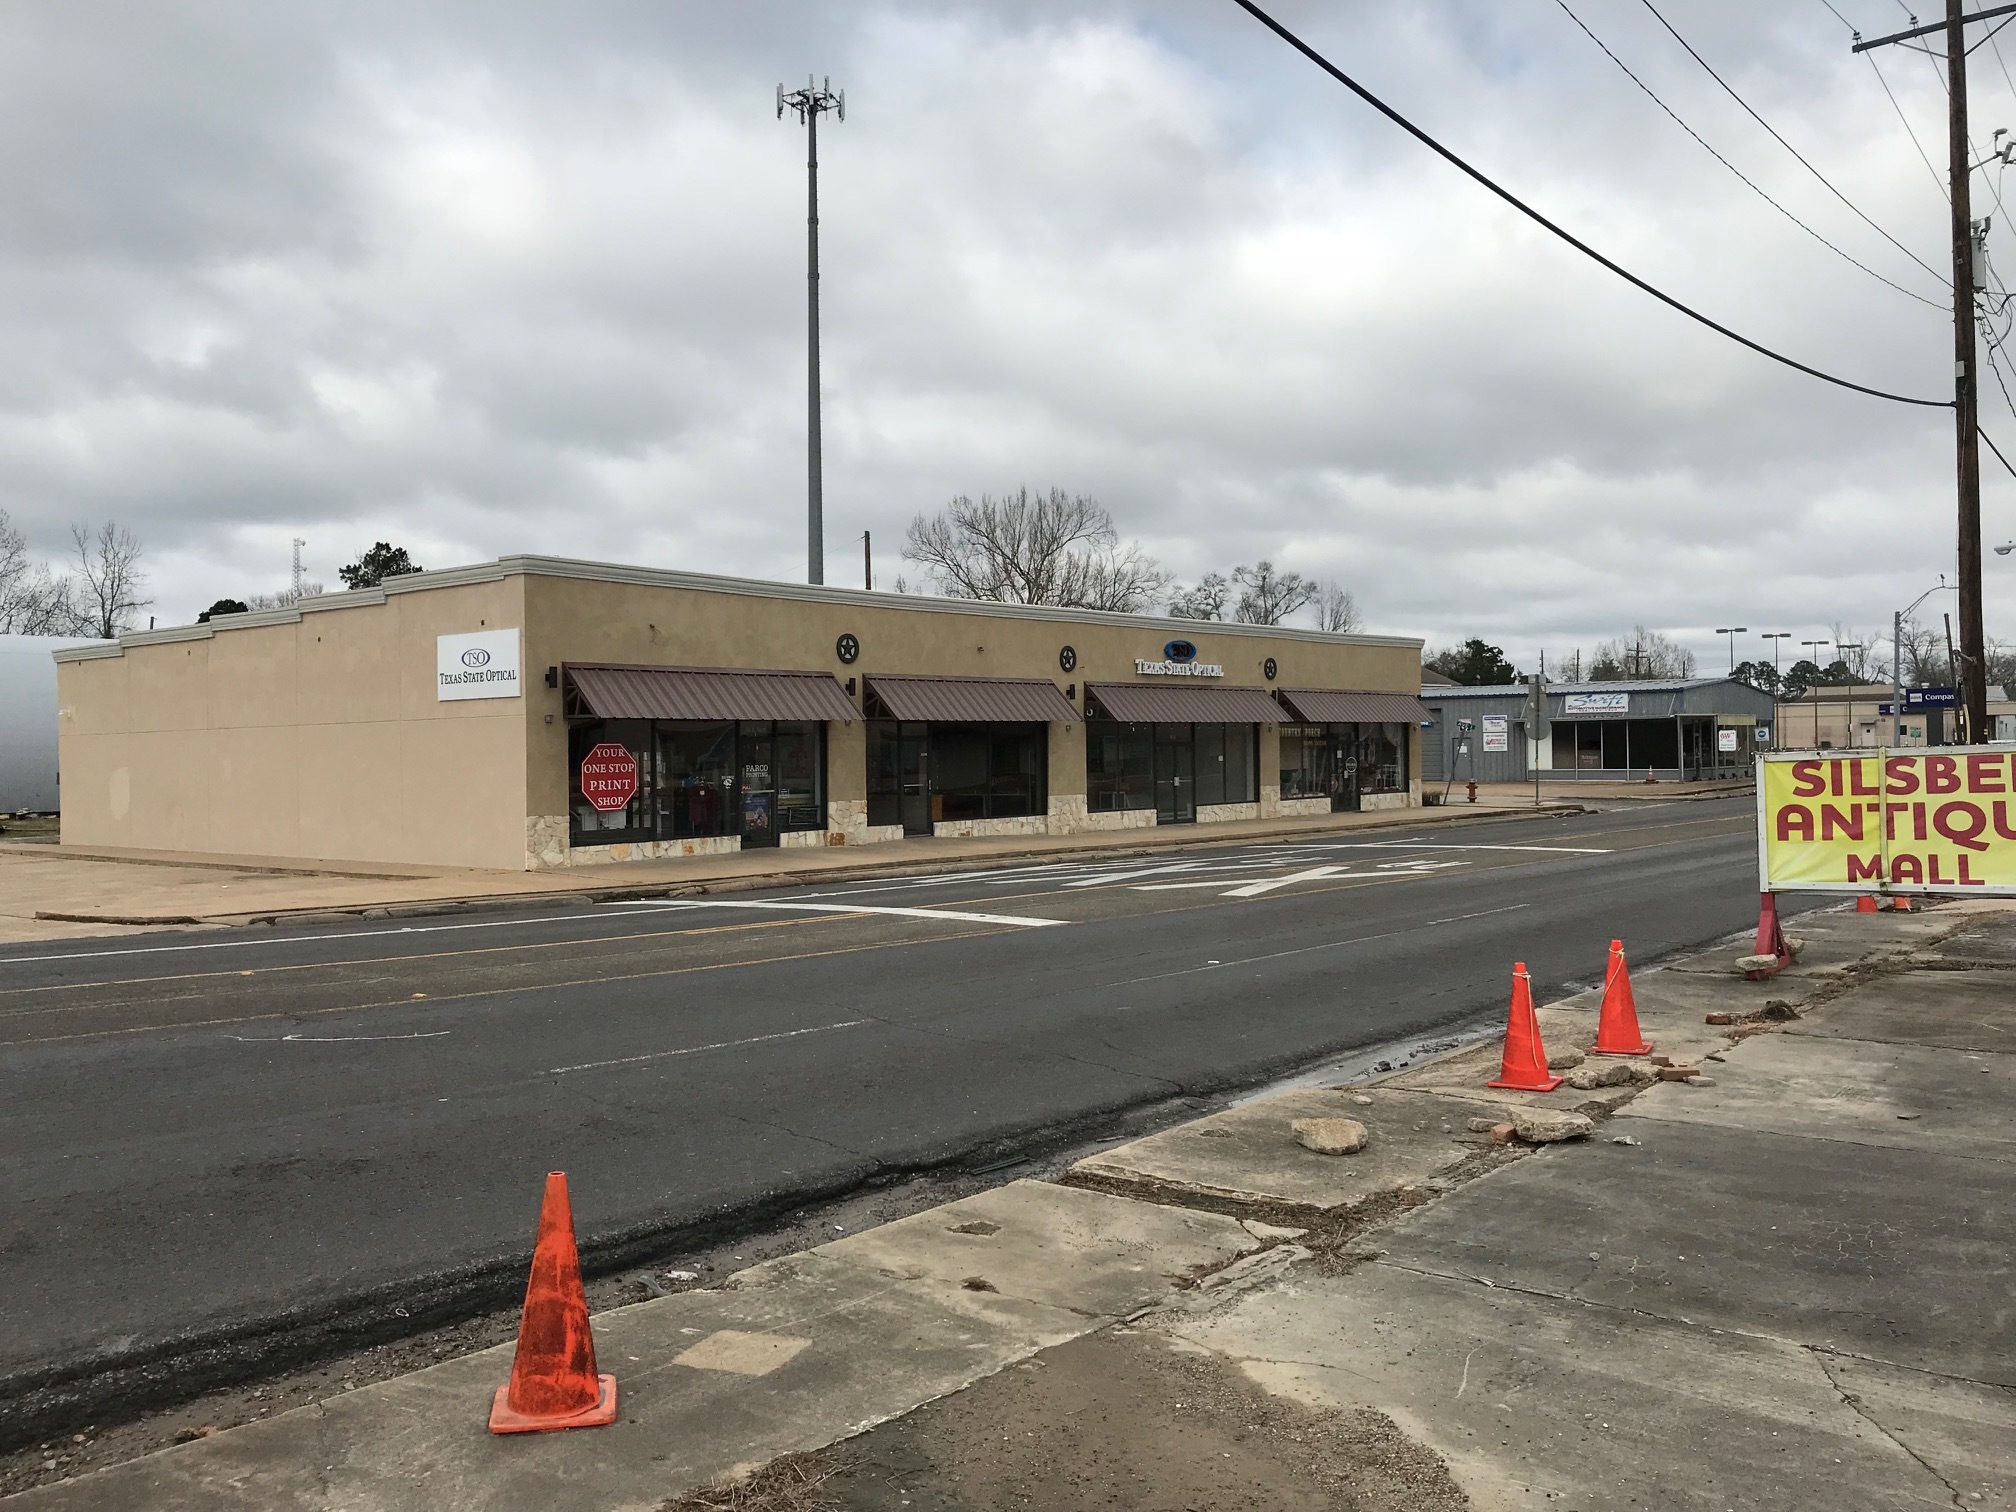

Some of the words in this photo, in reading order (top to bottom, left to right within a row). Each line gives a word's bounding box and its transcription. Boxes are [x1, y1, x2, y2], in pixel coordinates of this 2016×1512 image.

[467, 651, 486, 665] TSO
[439, 672, 462, 685] TEXAS
[462, 671, 485, 684] STATE
[485, 669, 517, 682] OPTICAL
[1925, 693, 1955, 702] Compas
[595, 748, 625, 758] YOUR
[584, 763, 607, 774] ONE
[608, 763, 635, 773] STOP
[745, 763, 769, 773] PARCO
[1791, 754, 2016, 797] SILSBE
[589, 778, 631, 791] PRINT
[597, 796, 624, 806] SHOP
[1846, 853, 1986, 886] MALL
